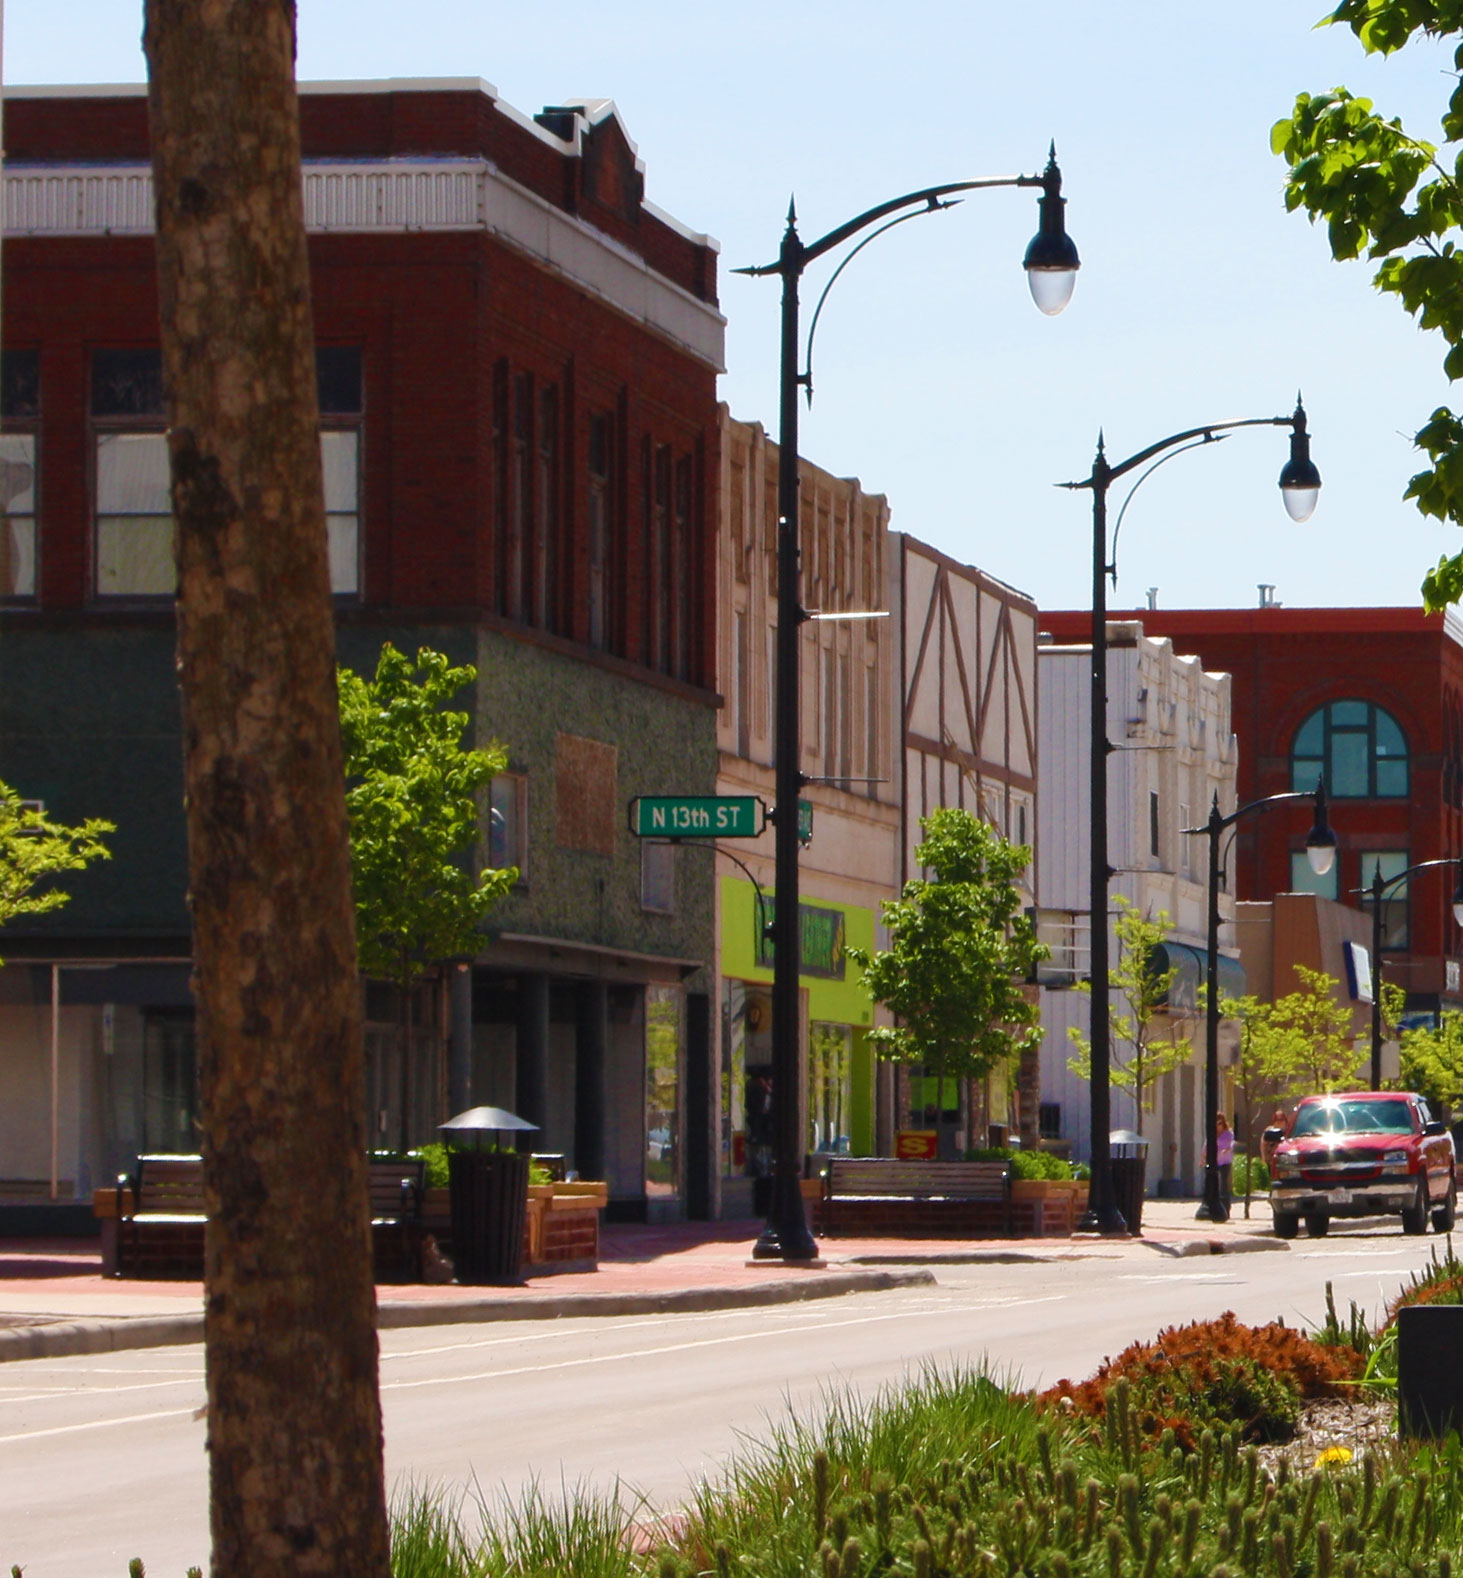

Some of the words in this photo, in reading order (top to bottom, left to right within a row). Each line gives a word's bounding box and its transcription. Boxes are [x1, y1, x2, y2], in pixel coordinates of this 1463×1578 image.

[652, 807, 665, 828] N
[672, 807, 709, 828] 13th
[716, 806, 741, 828] ST
